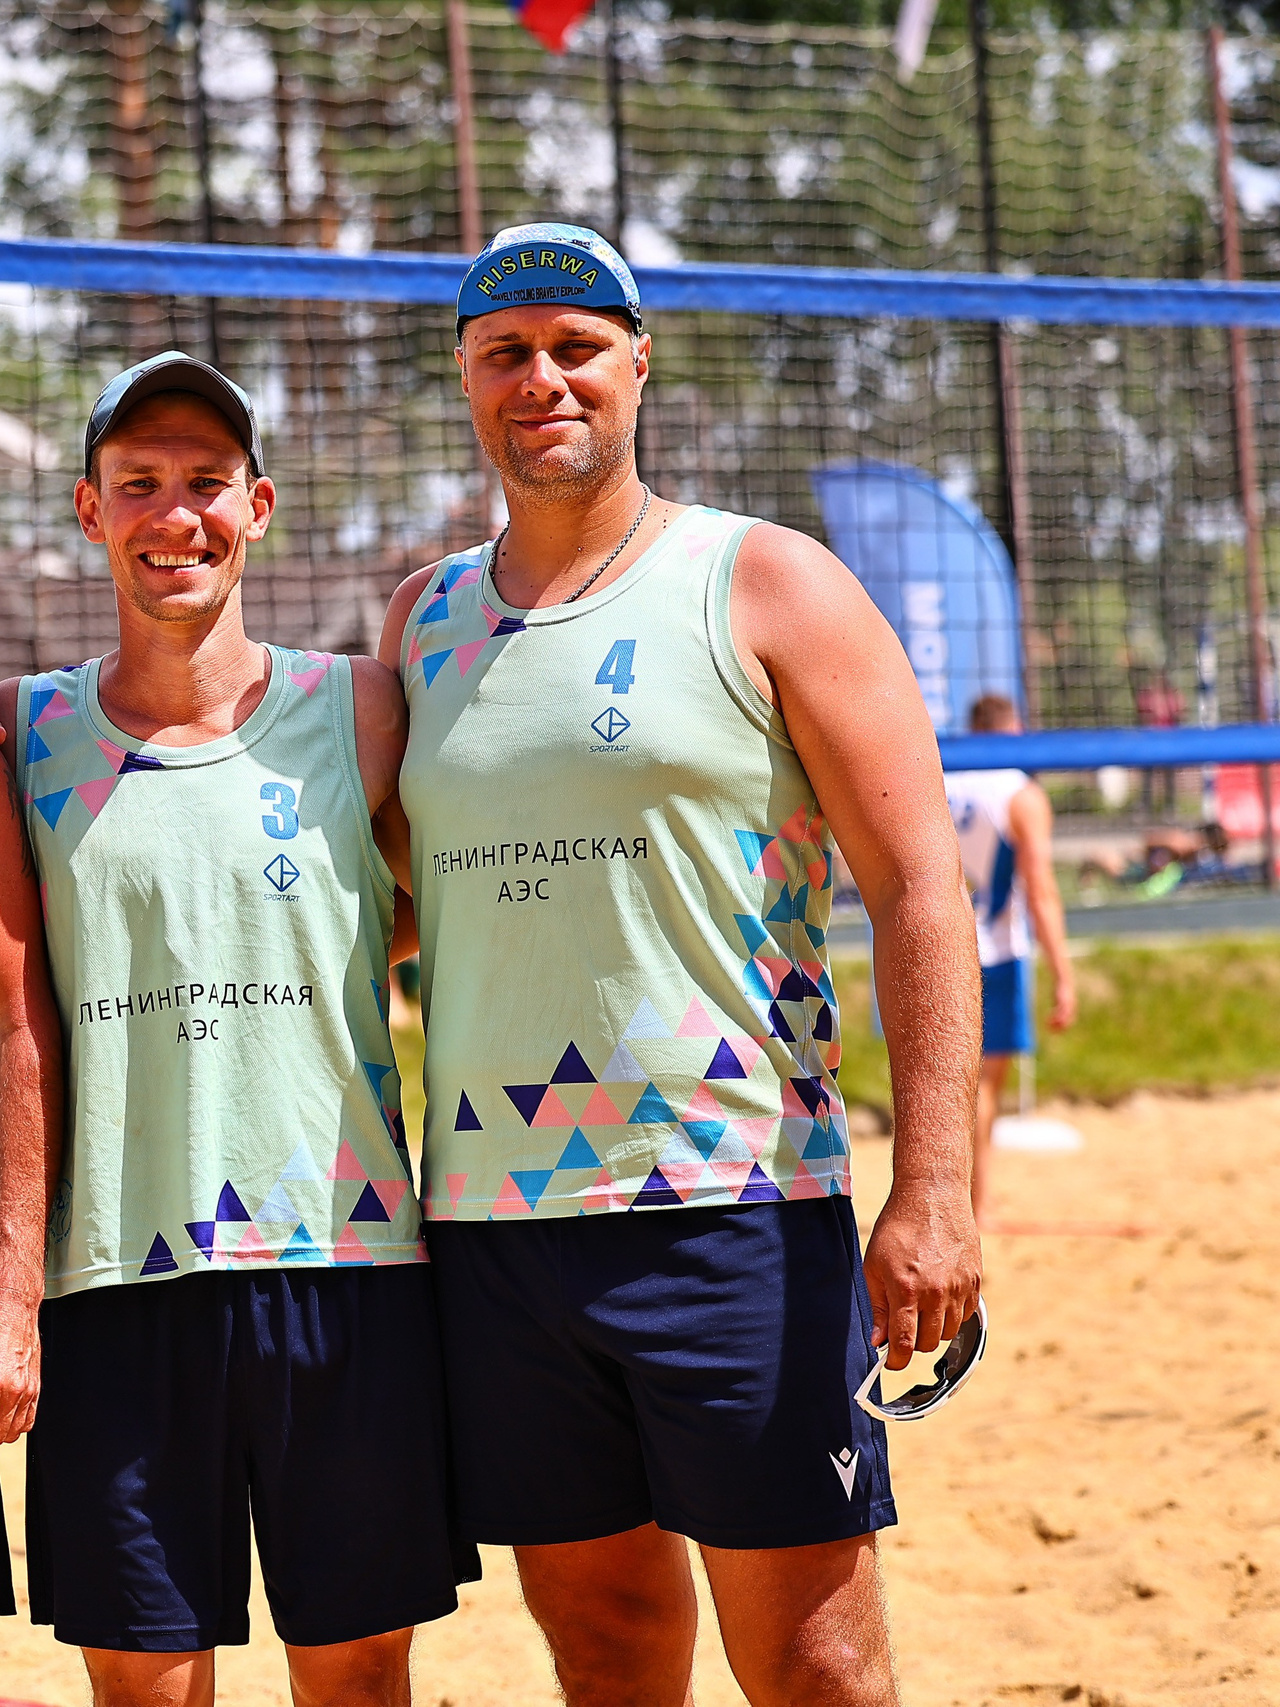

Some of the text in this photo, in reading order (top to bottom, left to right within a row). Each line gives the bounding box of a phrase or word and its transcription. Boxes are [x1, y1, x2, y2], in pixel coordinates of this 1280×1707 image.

[476, 249, 600, 297] HISERWA
[490, 286, 586, 301] BRAVELY CYCLING BRAVELY EXPLORE
[594, 639, 637, 694] 4
[589, 744, 630, 753] SPORTART
[260, 782, 300, 840] 3
[432, 837, 648, 876] ЛЕНИНГРАДСКАЯ
[263, 893, 301, 903] SPORTART
[497, 878, 550, 903] АЭС
[78, 983, 314, 1025] ЛЕНИНГРАДСКАЯ
[176, 1019, 219, 1043] АЭС
